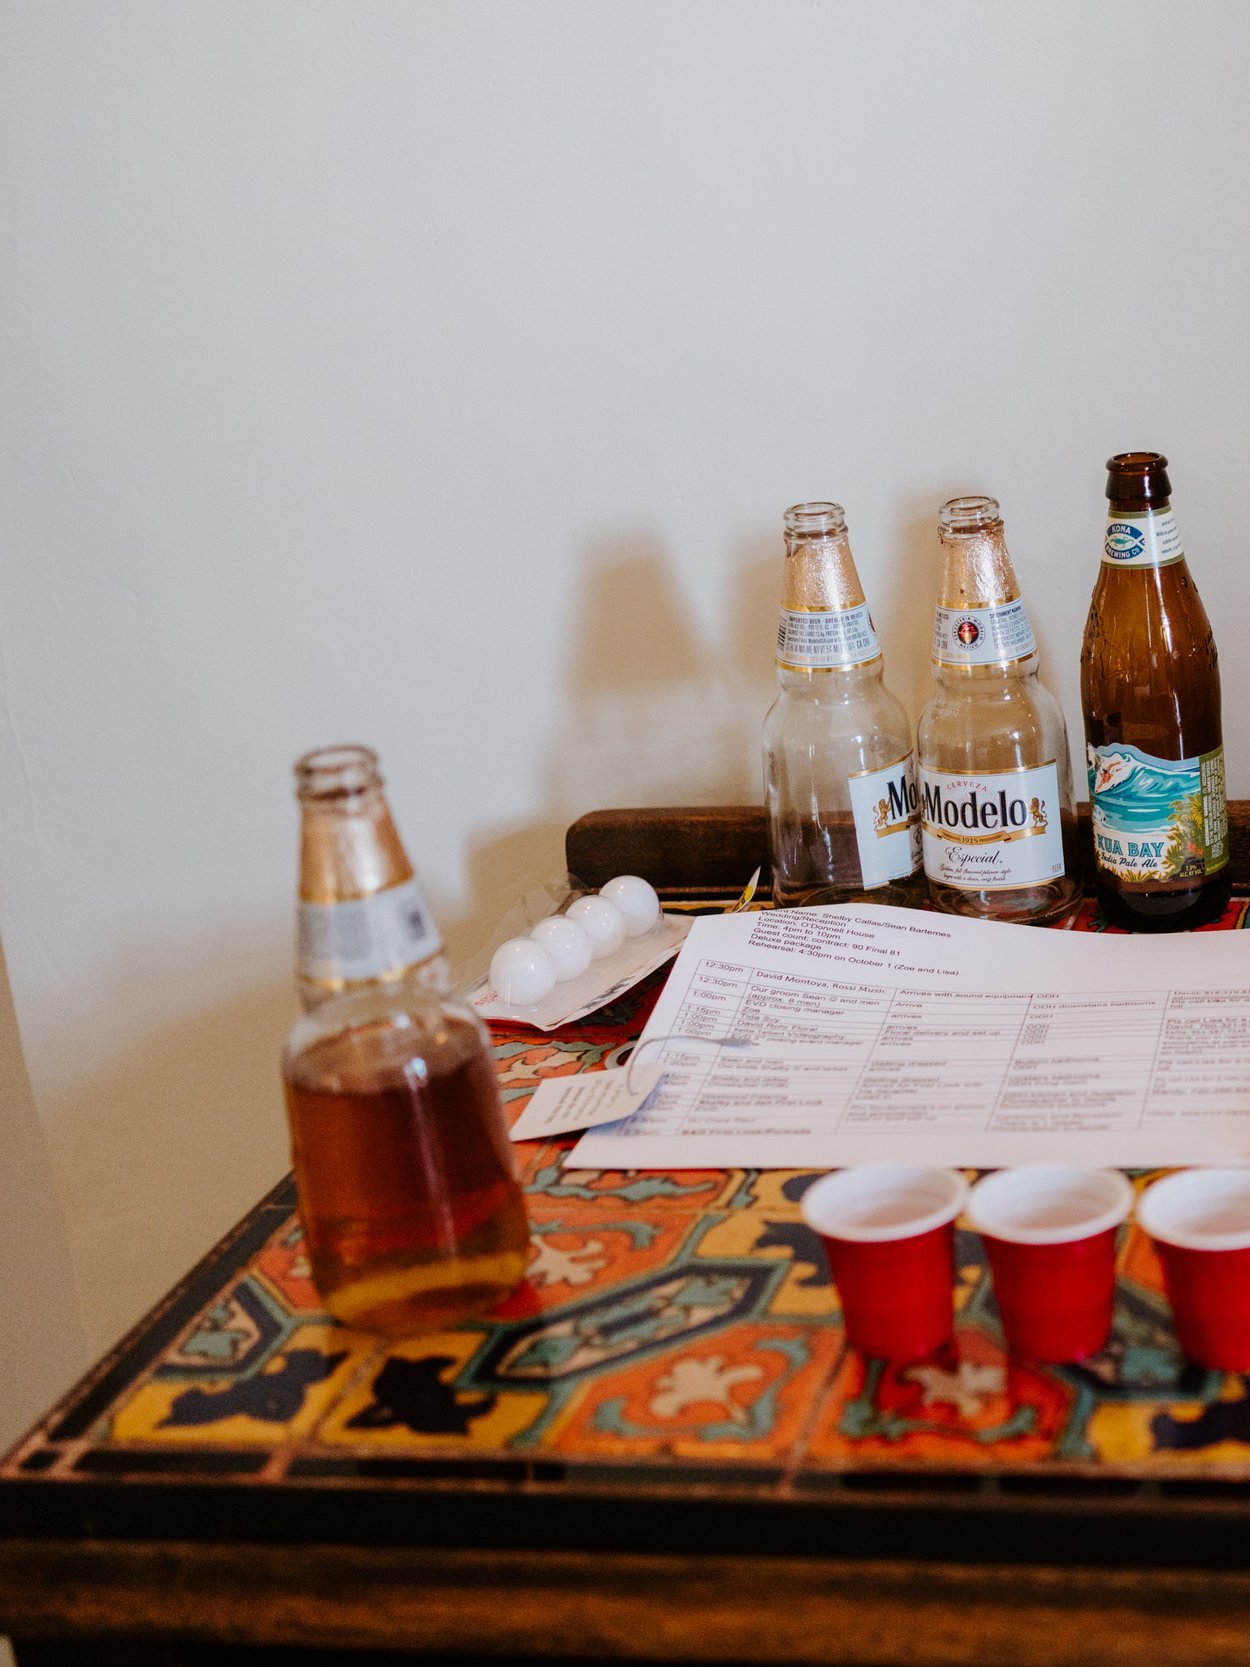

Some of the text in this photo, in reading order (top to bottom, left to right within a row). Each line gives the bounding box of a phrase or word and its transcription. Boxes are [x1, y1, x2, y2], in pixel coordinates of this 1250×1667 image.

[1112, 525, 1131, 535] KONA
[1105, 544, 1131, 558] BREWING
[946, 780, 987, 793] CERVEZA
[923, 780, 1028, 829] Modelo
[961, 836, 979, 844] 1925
[944, 846, 1001, 868] Especial
[1128, 842, 1165, 858] BAY
[1100, 852, 1159, 868] India Pale Ale
[758, 916, 875, 939] Location: O'Donnell House
[761, 911, 847, 928] Wedding/Reception
[822, 913, 851, 922] Shelby
[854, 917, 907, 931] Callas/Sean
[757, 921, 780, 930] Time:
[783, 926, 803, 934] 4pm
[816, 931, 841, 940] 10pm
[750, 933, 822, 951] Deluxe package
[753, 927, 781, 936] Guest
[782, 932, 809, 942] count:
[812, 936, 850, 948] contract:
[852, 943, 863, 951] 90
[865, 946, 888, 954] Final
[748, 940, 796, 953] Rehearsal:
[798, 949, 832, 960] 4:30pm
[848, 956, 884, 968] October
[894, 963, 915, 972] (Zoe
[937, 968, 960, 977] Lisa)
[704, 961, 744, 974] 12:30pm
[699, 976, 738, 989] 12:30pm
[756, 971, 889, 994] David Montoya, Rossi Music
[692, 990, 727, 1002] 1:00pm
[750, 985, 768, 993] Our
[770, 989, 800, 999] groom
[802, 993, 826, 1001] Sean
[899, 989, 932, 997] Arrives
[686, 1004, 721, 1016] 1:15pm
[745, 1000, 846, 1017] EVD closing manager
[684, 1012, 718, 1023] 1:00pm
[736, 1020, 763, 1029] David
